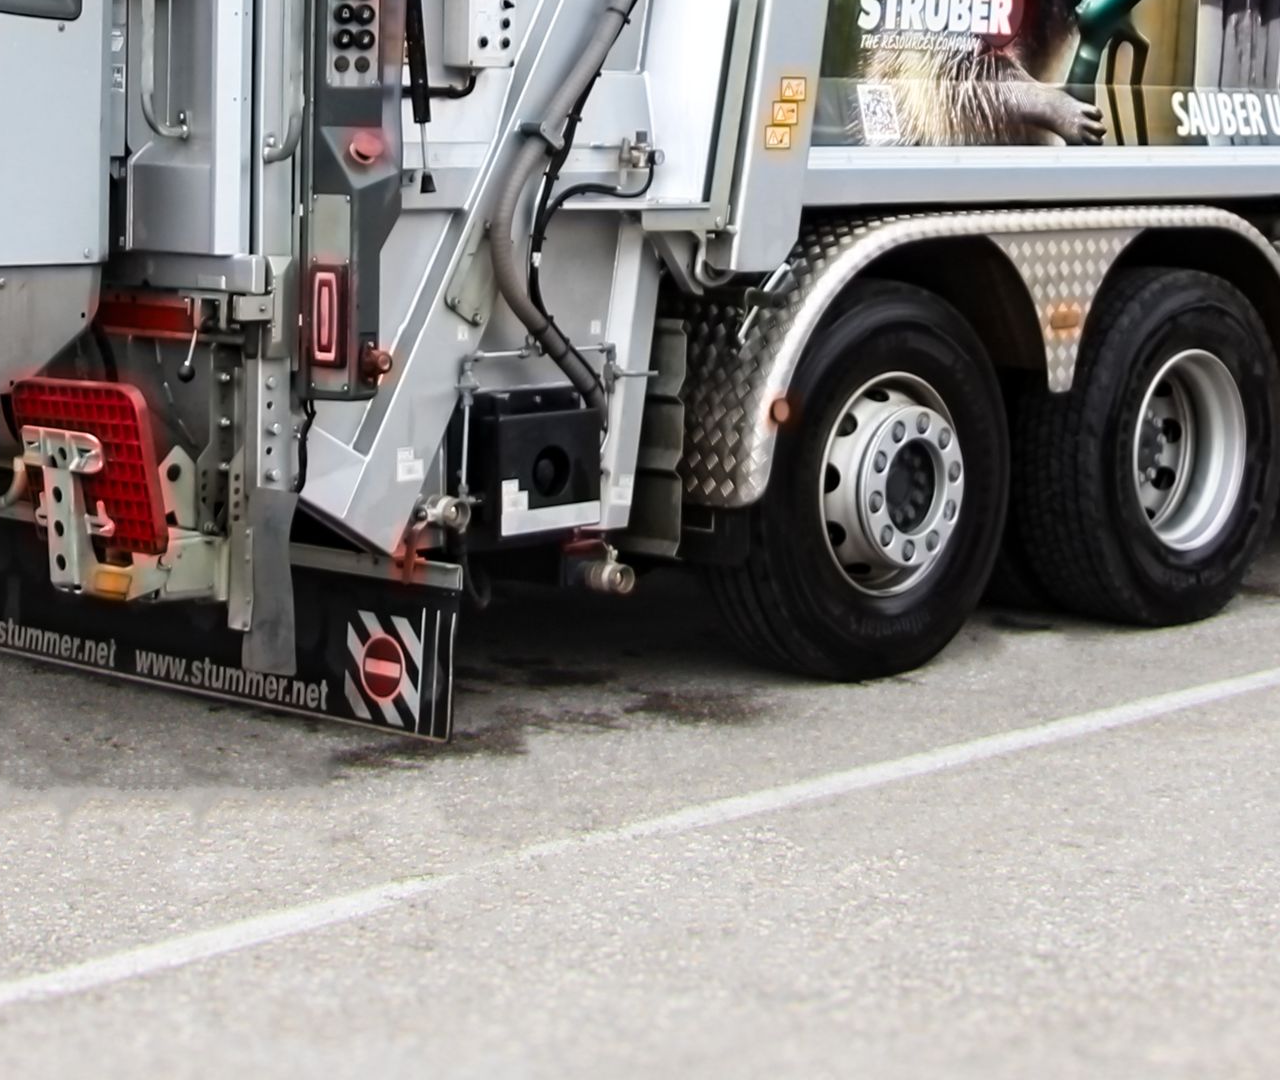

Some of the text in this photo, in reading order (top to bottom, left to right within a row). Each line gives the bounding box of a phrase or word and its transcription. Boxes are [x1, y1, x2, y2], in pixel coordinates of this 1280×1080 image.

[860, 34, 880, 49] THE
[880, 34, 934, 51] RESOURCES
[1171, 91, 1267, 137] SAUBER
[135, 648, 329, 711] www.stummer.net
